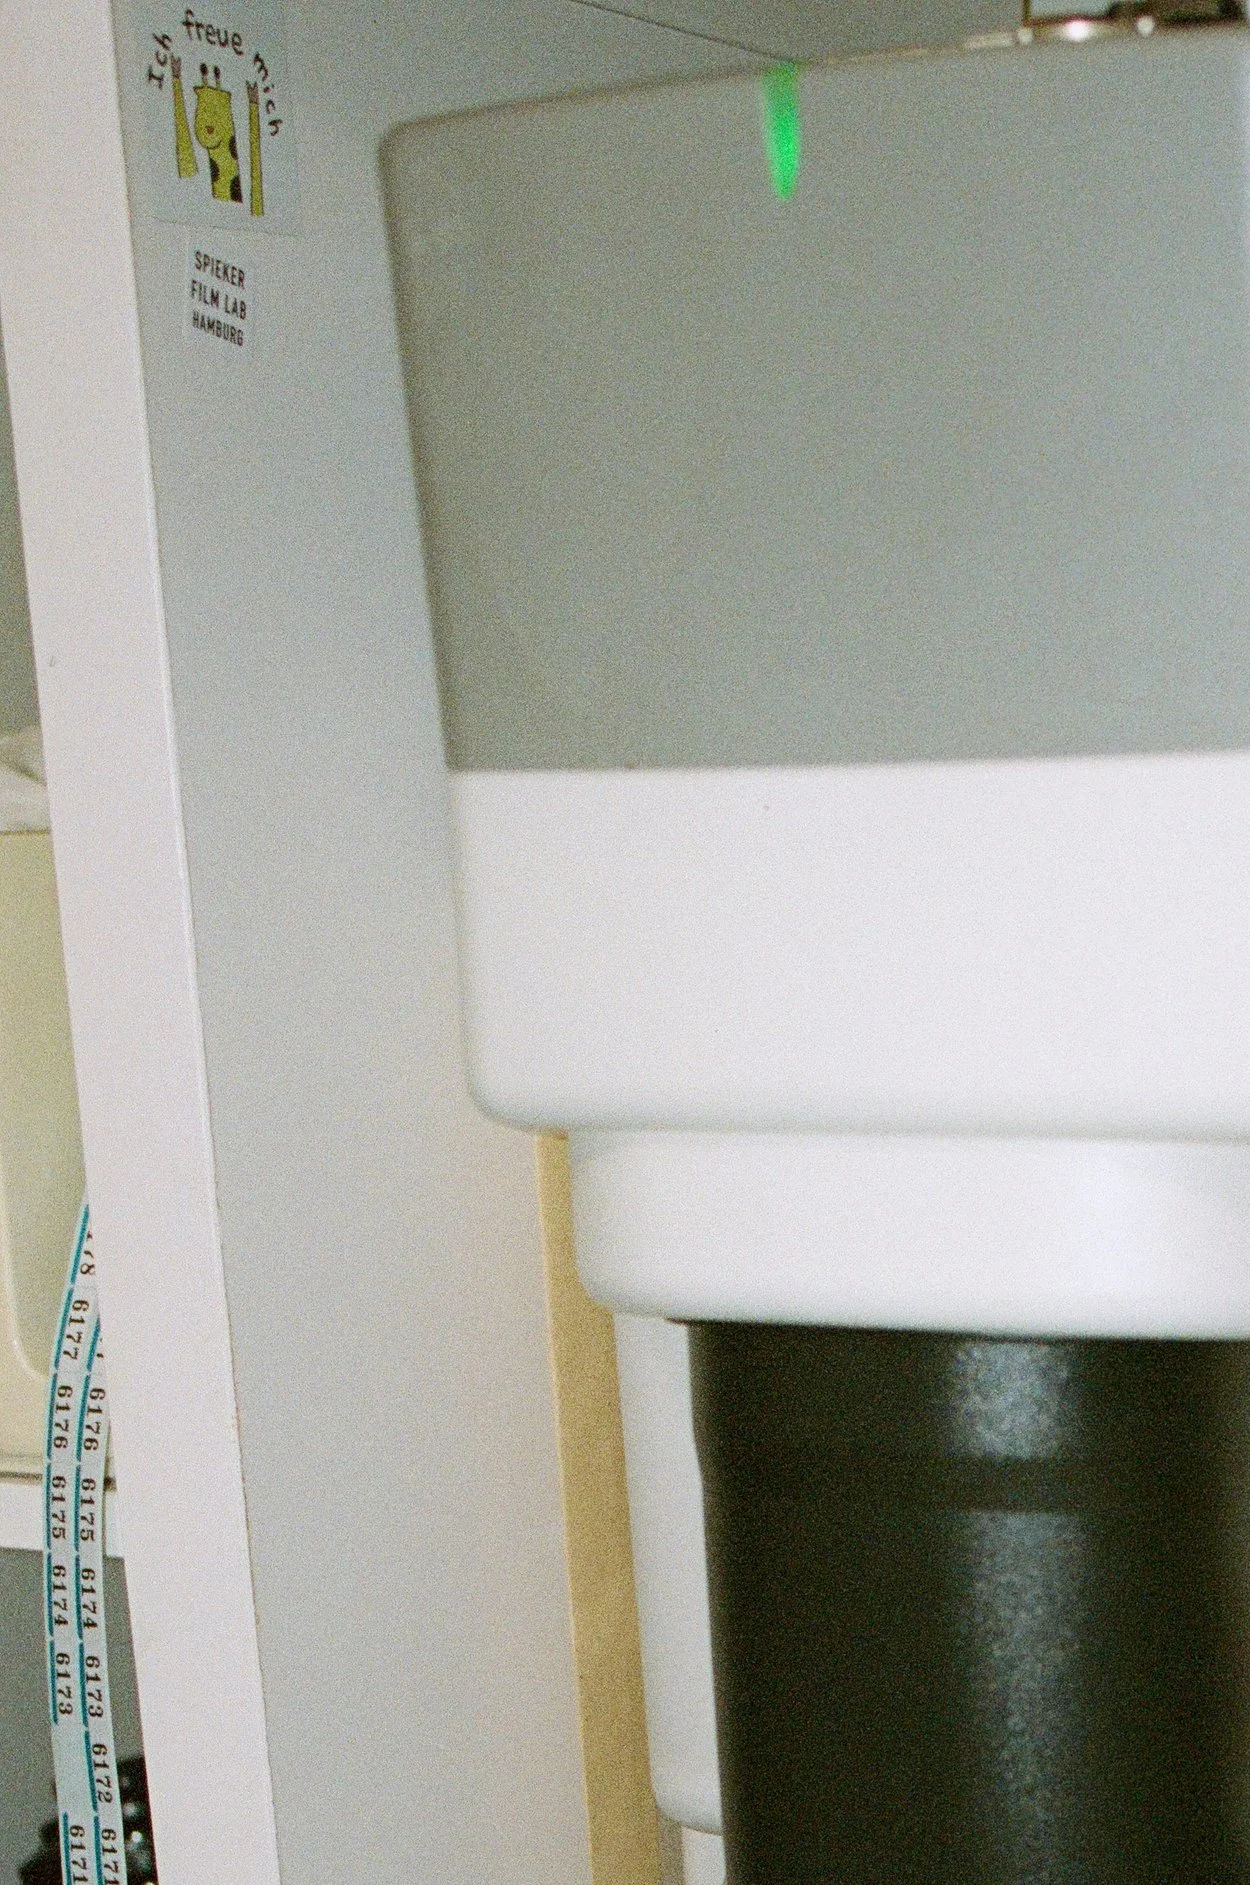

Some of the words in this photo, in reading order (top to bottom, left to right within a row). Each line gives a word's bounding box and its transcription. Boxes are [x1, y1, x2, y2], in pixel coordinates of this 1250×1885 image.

[147, 32, 173, 90] Ich
[181, 8, 245, 56] freue
[252, 51, 283, 137] mich
[191, 279, 220, 310] FILM
[224, 293, 247, 321] LAB
[194, 250, 246, 291] SPIEKER
[192, 309, 244, 347] HAMBURG
[63, 1298, 90, 1361] 6177
[53, 1385, 73, 1449] 6176
[83, 1387, 105, 1451] 6176
[51, 1474, 68, 1541] 6175
[79, 1478, 96, 1542] 6175
[50, 1564, 69, 1626] 6174
[80, 1567, 98, 1629] 6174
[55, 1652, 73, 1715] 6173
[85, 1655, 104, 1718] 6173
[91, 1743, 114, 1804] 6172
[69, 1824, 89, 1883] 6171
